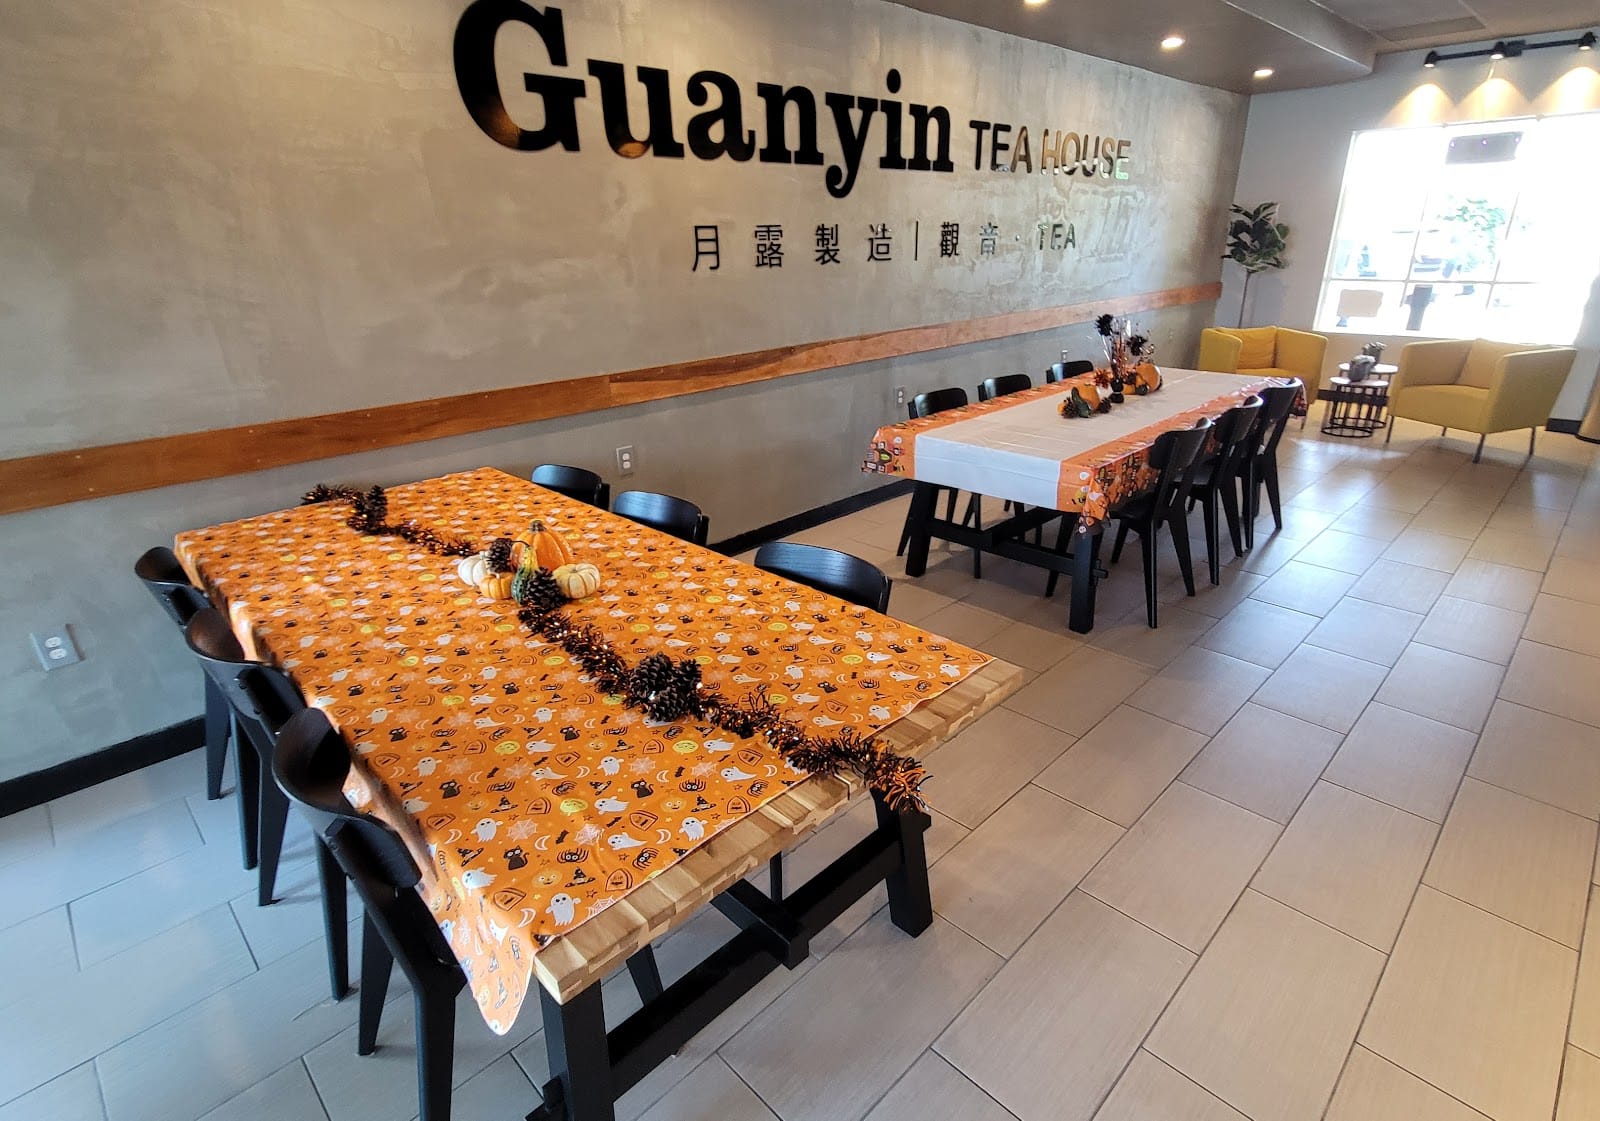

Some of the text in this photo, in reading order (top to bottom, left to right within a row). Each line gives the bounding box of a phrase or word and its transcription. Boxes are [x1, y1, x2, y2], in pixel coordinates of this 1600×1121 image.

[453, 0, 1132, 198] Guanyin TEA HOUSE
[1037, 222, 1077, 252] TEA
